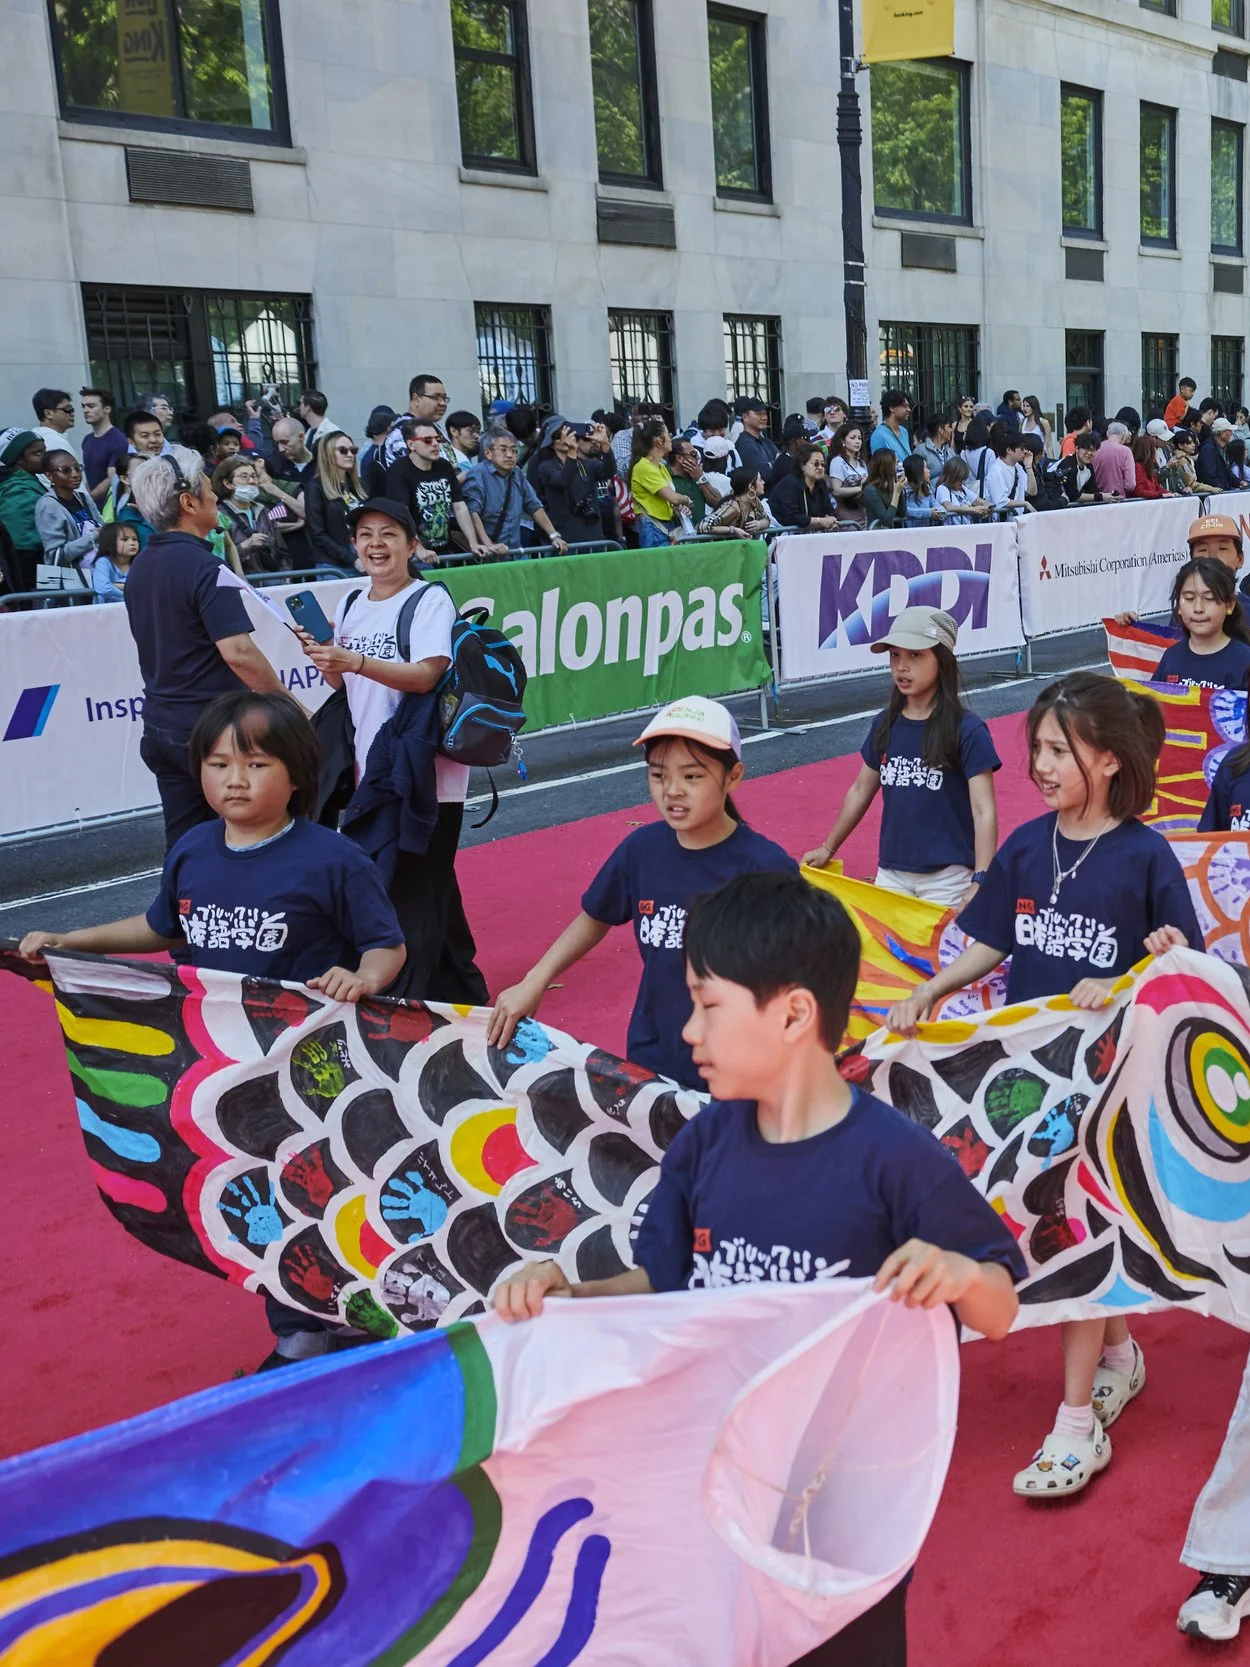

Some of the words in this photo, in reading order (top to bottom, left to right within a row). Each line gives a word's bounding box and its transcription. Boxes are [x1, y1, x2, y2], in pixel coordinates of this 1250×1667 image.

[1053, 558, 1099, 579] Mitsubishi
[1099, 553, 1149, 575] Corporation
[1149, 550, 1188, 568] (Americas)
[818, 543, 992, 650] KDDI
[196, 904, 286, 924] ブルックリン
[1039, 907, 1117, 936] ブルックリン
[1015, 913, 1119, 968] 日本語学園
[554, 1176, 582, 1209] あいら
